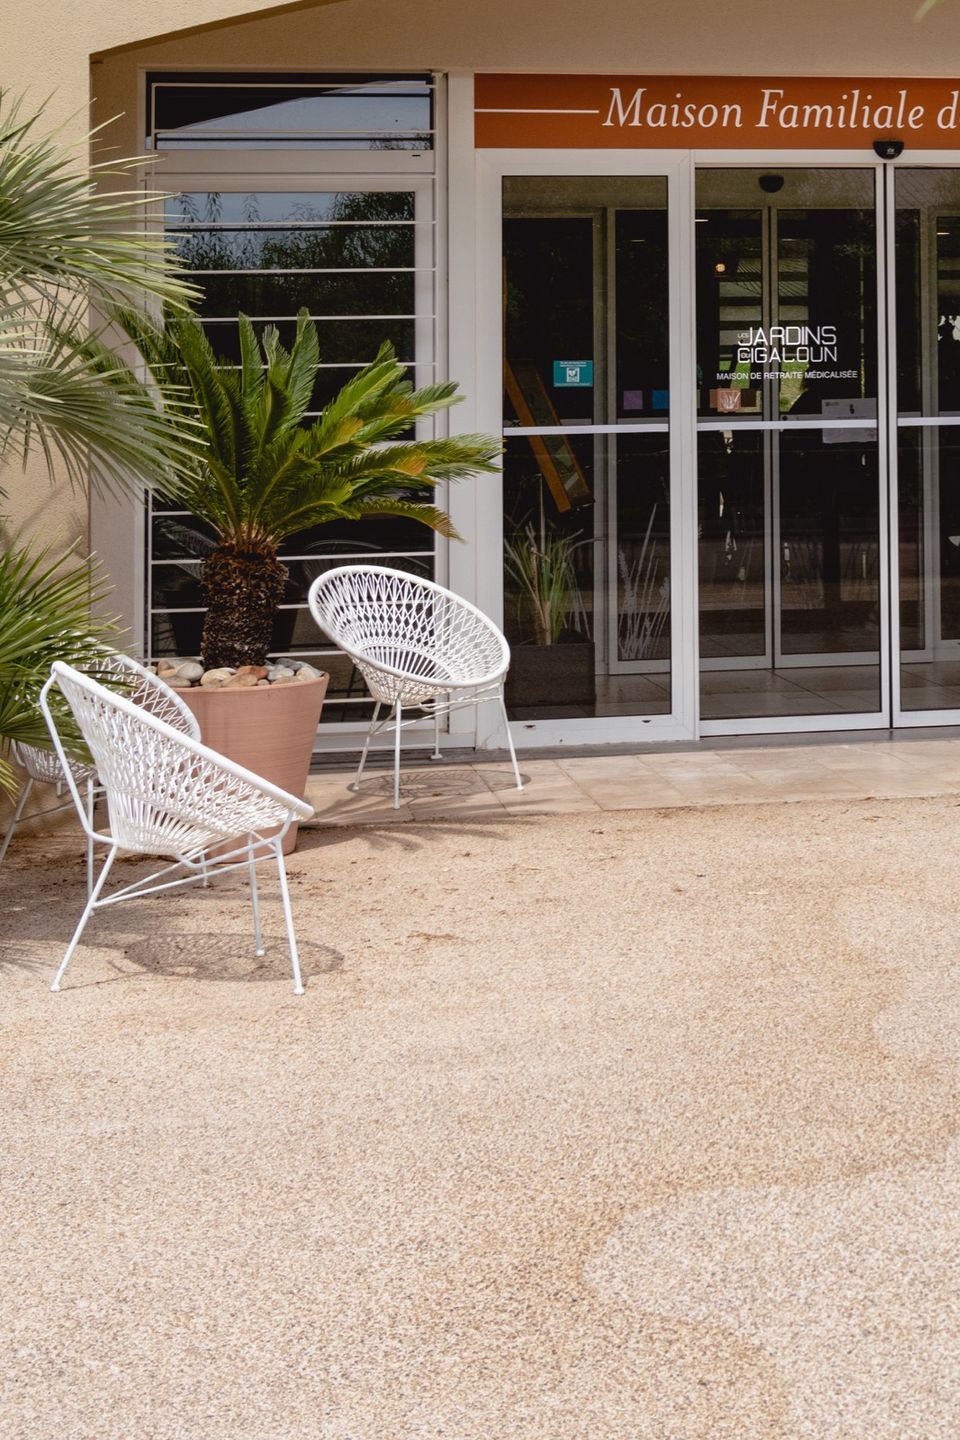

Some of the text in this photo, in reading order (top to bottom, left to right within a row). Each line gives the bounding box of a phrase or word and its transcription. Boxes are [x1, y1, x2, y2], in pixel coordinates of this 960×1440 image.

[602, 87, 743, 129] Maison
[755, 88, 925, 130] Familiale
[737, 326, 837, 346] JARDINS
[737, 346, 838, 364] CIGALOUN
[716, 370, 858, 380] MAISON DE RETRAITE MÉDICALISÉE
